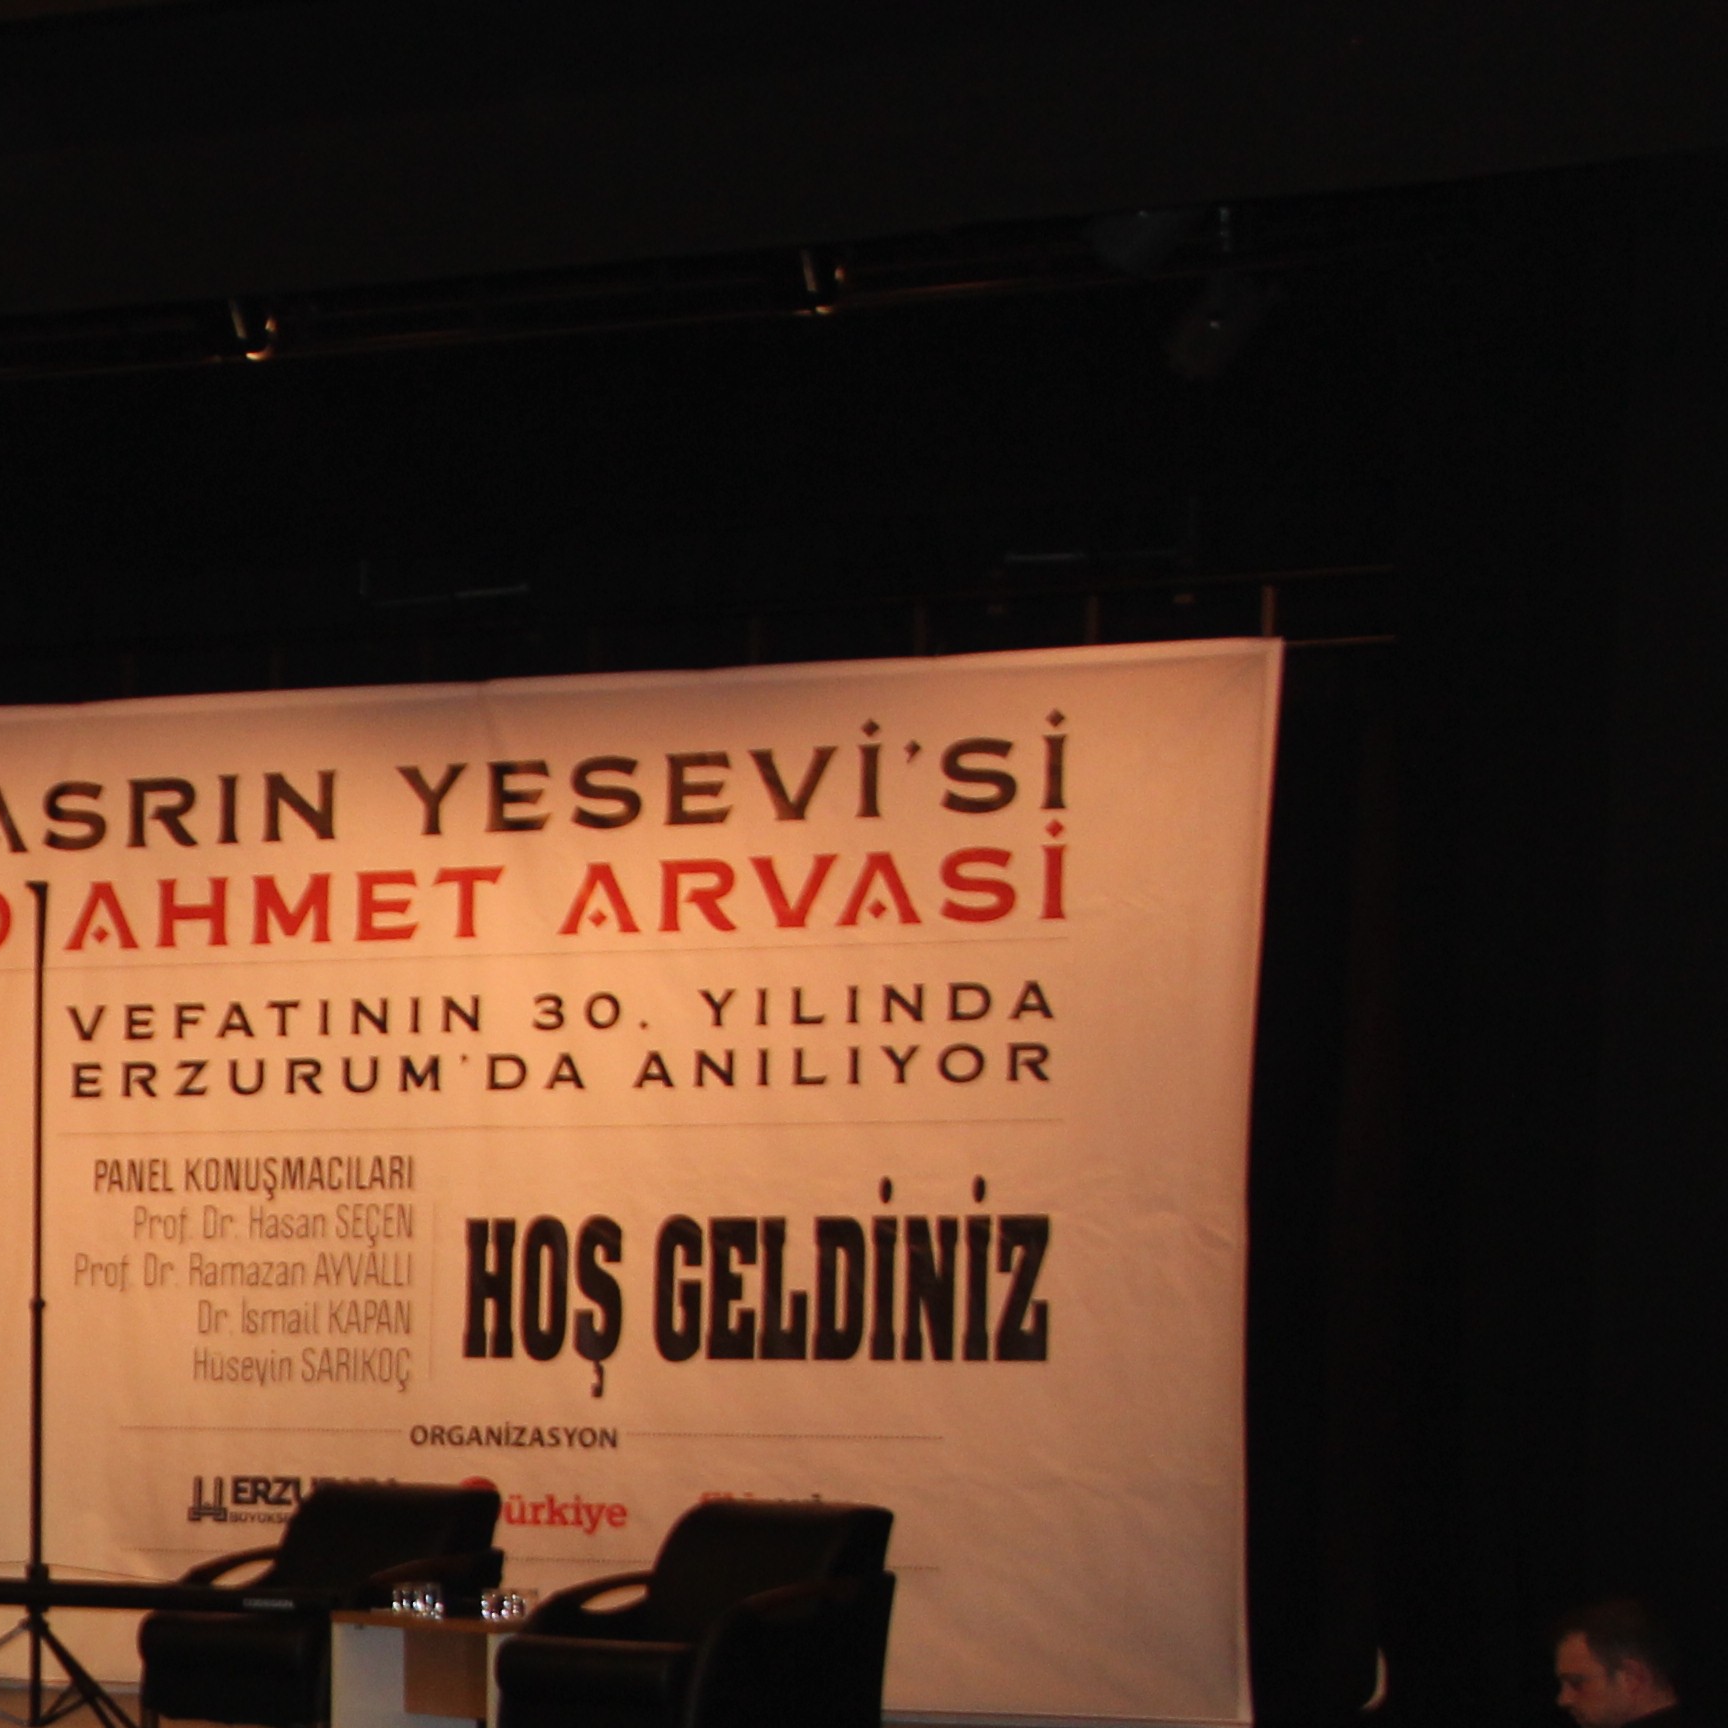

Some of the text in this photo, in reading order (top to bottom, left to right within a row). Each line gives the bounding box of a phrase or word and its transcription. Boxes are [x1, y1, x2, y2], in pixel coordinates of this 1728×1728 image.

[65, 866, 503, 952] AHMET
[557, 818, 1067, 936] ARVASİ
[66, 980, 1055, 1043] VEFATININ 30. YILINDA
[71, 1042, 1051, 1100] ERZURUM'DA ANILIYOR
[94, 1155, 414, 1202] PANEL KONUŞMACILARI
[249, 1205, 328, 1242] Hasan
[335, 1202, 415, 1249] SEÇEN
[188, 1251, 308, 1289] Ramazan
[463, 1176, 1050, 1399] HOŞ GELDİNİZ
[328, 1299, 412, 1336] KAPAN
[300, 1347, 412, 1395] SARIKOÇ
[409, 1422, 618, 1450] ORGANİZASYON
[501, 1492, 630, 1537] ürkiye
